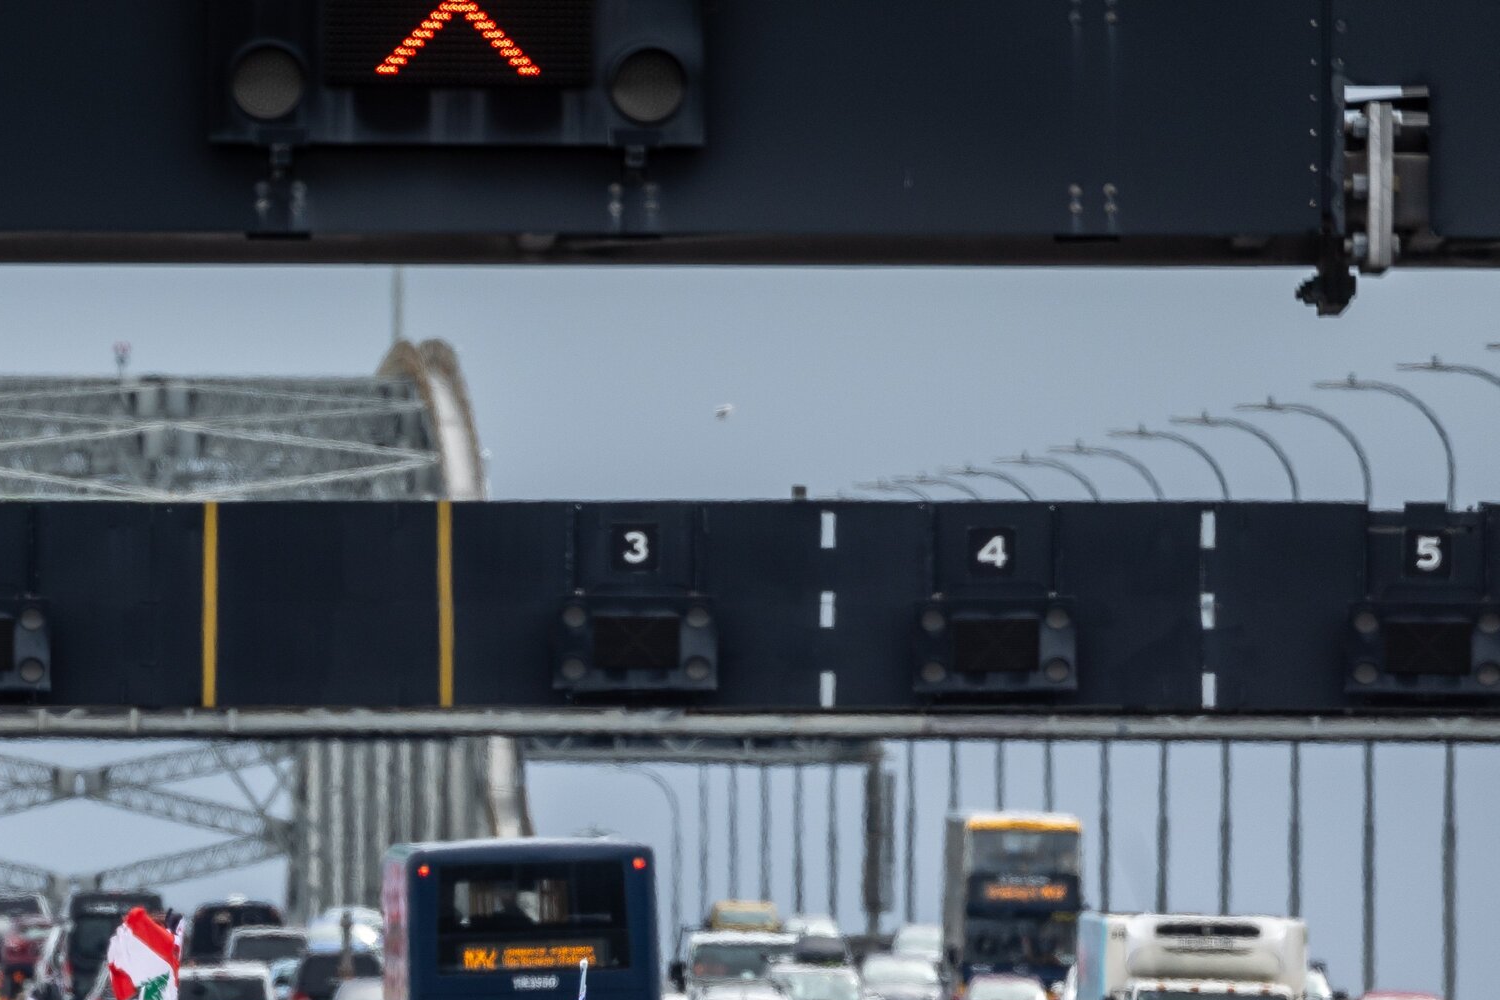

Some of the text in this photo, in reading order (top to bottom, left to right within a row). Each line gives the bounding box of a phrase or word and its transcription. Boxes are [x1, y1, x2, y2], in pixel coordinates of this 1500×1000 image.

[623, 530, 649, 564] 3
[976, 534, 1008, 568] 4
[1415, 535, 1443, 570] 5
